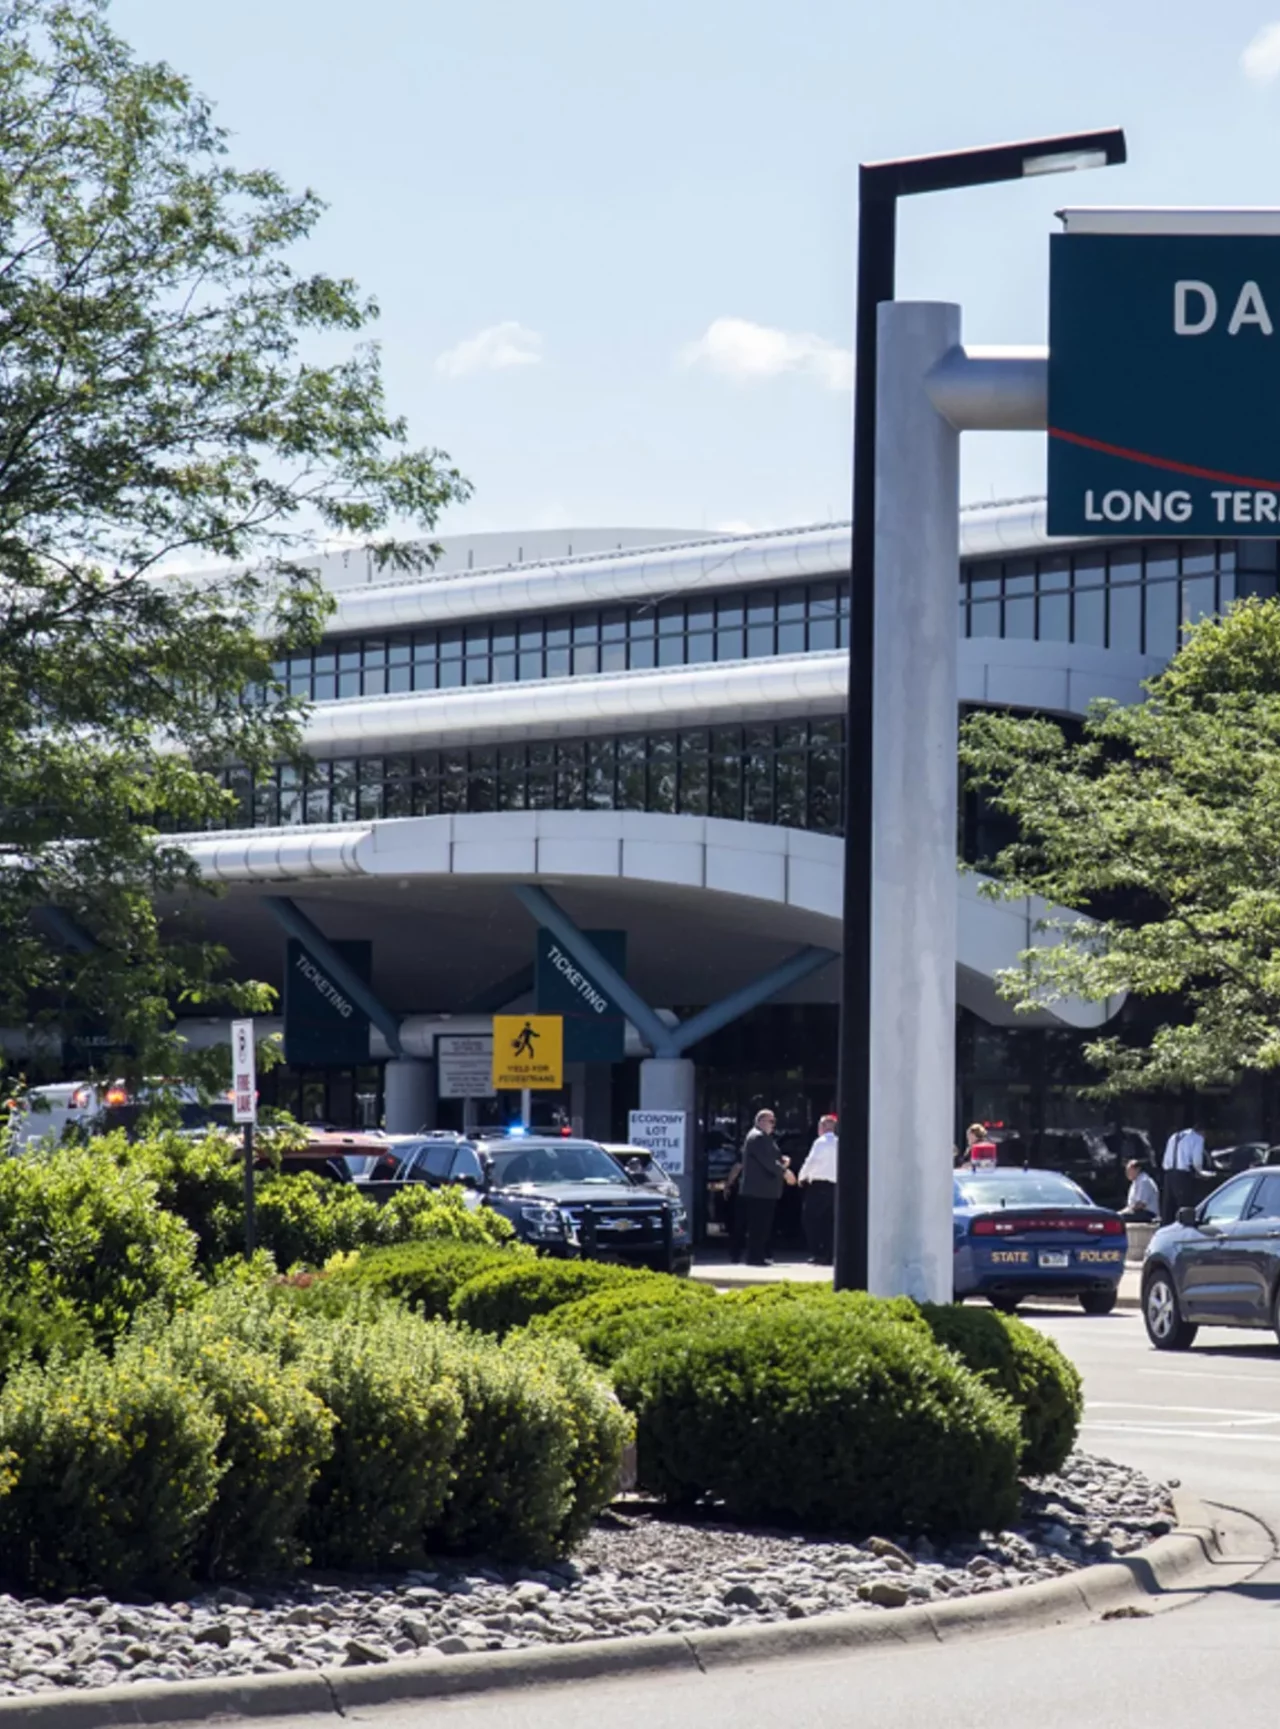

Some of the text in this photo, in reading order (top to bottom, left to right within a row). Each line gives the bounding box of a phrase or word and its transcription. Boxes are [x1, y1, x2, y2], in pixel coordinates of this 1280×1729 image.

[1085, 489, 1193, 522] LONG
[547, 946, 607, 1013] TICKETING
[296, 955, 353, 1018] TICKETING
[631, 1113, 684, 1124] ECONOMY
[645, 1126, 668, 1136] LOT
[632, 1137, 680, 1148] SHUTTLE
[652, 1150, 668, 1159] US
[661, 1161, 681, 1171] OFF
[991, 1251, 1029, 1263] STATE
[1079, 1250, 1121, 1262] POLICE
